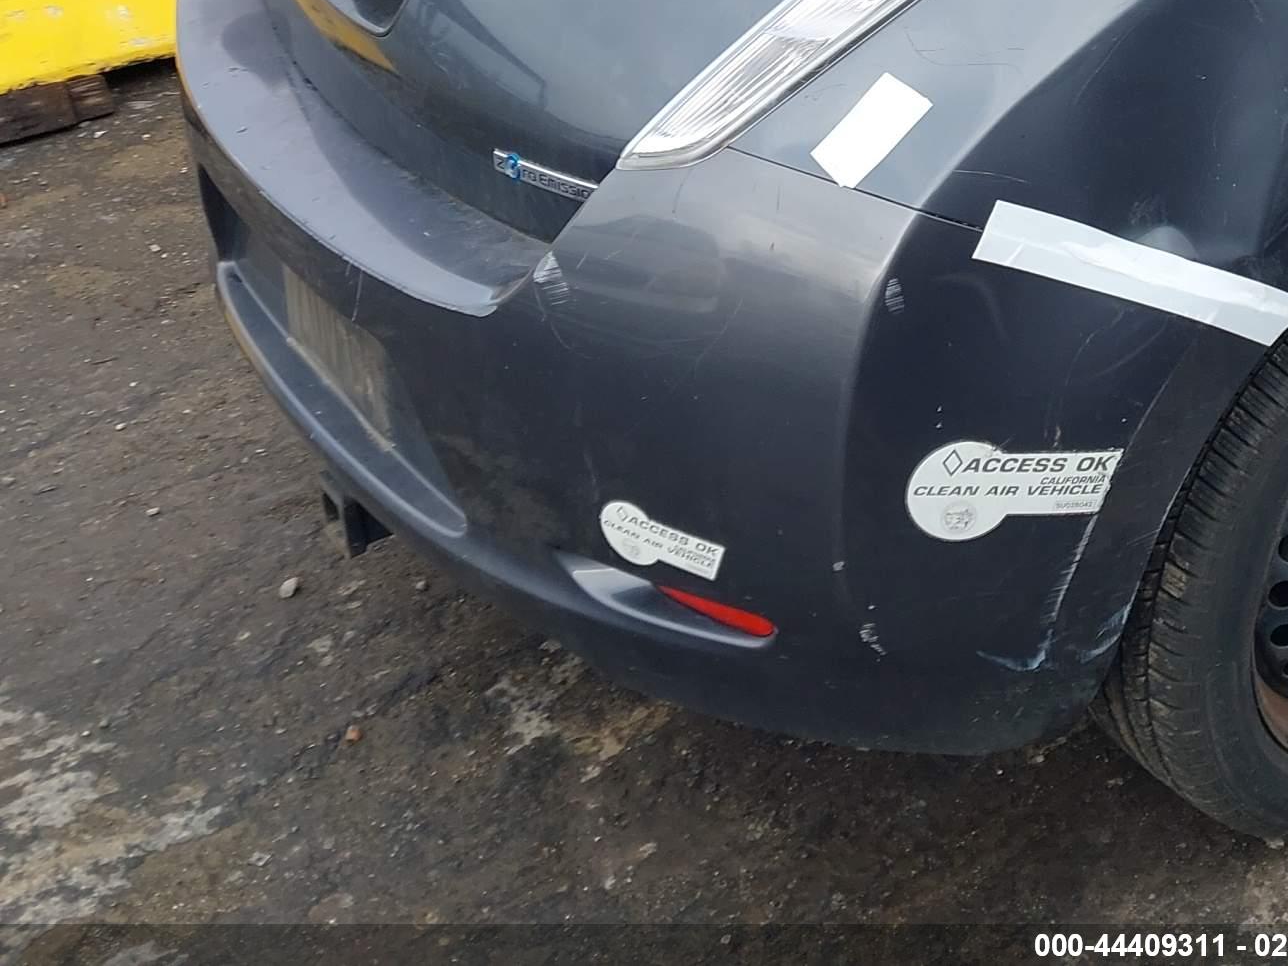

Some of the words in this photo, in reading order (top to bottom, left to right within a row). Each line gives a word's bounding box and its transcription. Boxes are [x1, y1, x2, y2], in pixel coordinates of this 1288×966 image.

[962, 457, 1068, 473] ACCESS
[1076, 456, 1115, 472] OK
[1040, 475, 1106, 485] CALIFORNIA
[913, 486, 980, 496] CLEAN
[984, 485, 1019, 496] AIR
[1027, 484, 1103, 496] VEHICLE
[628, 516, 690, 546] ACCESS
[695, 542, 719, 556] OK
